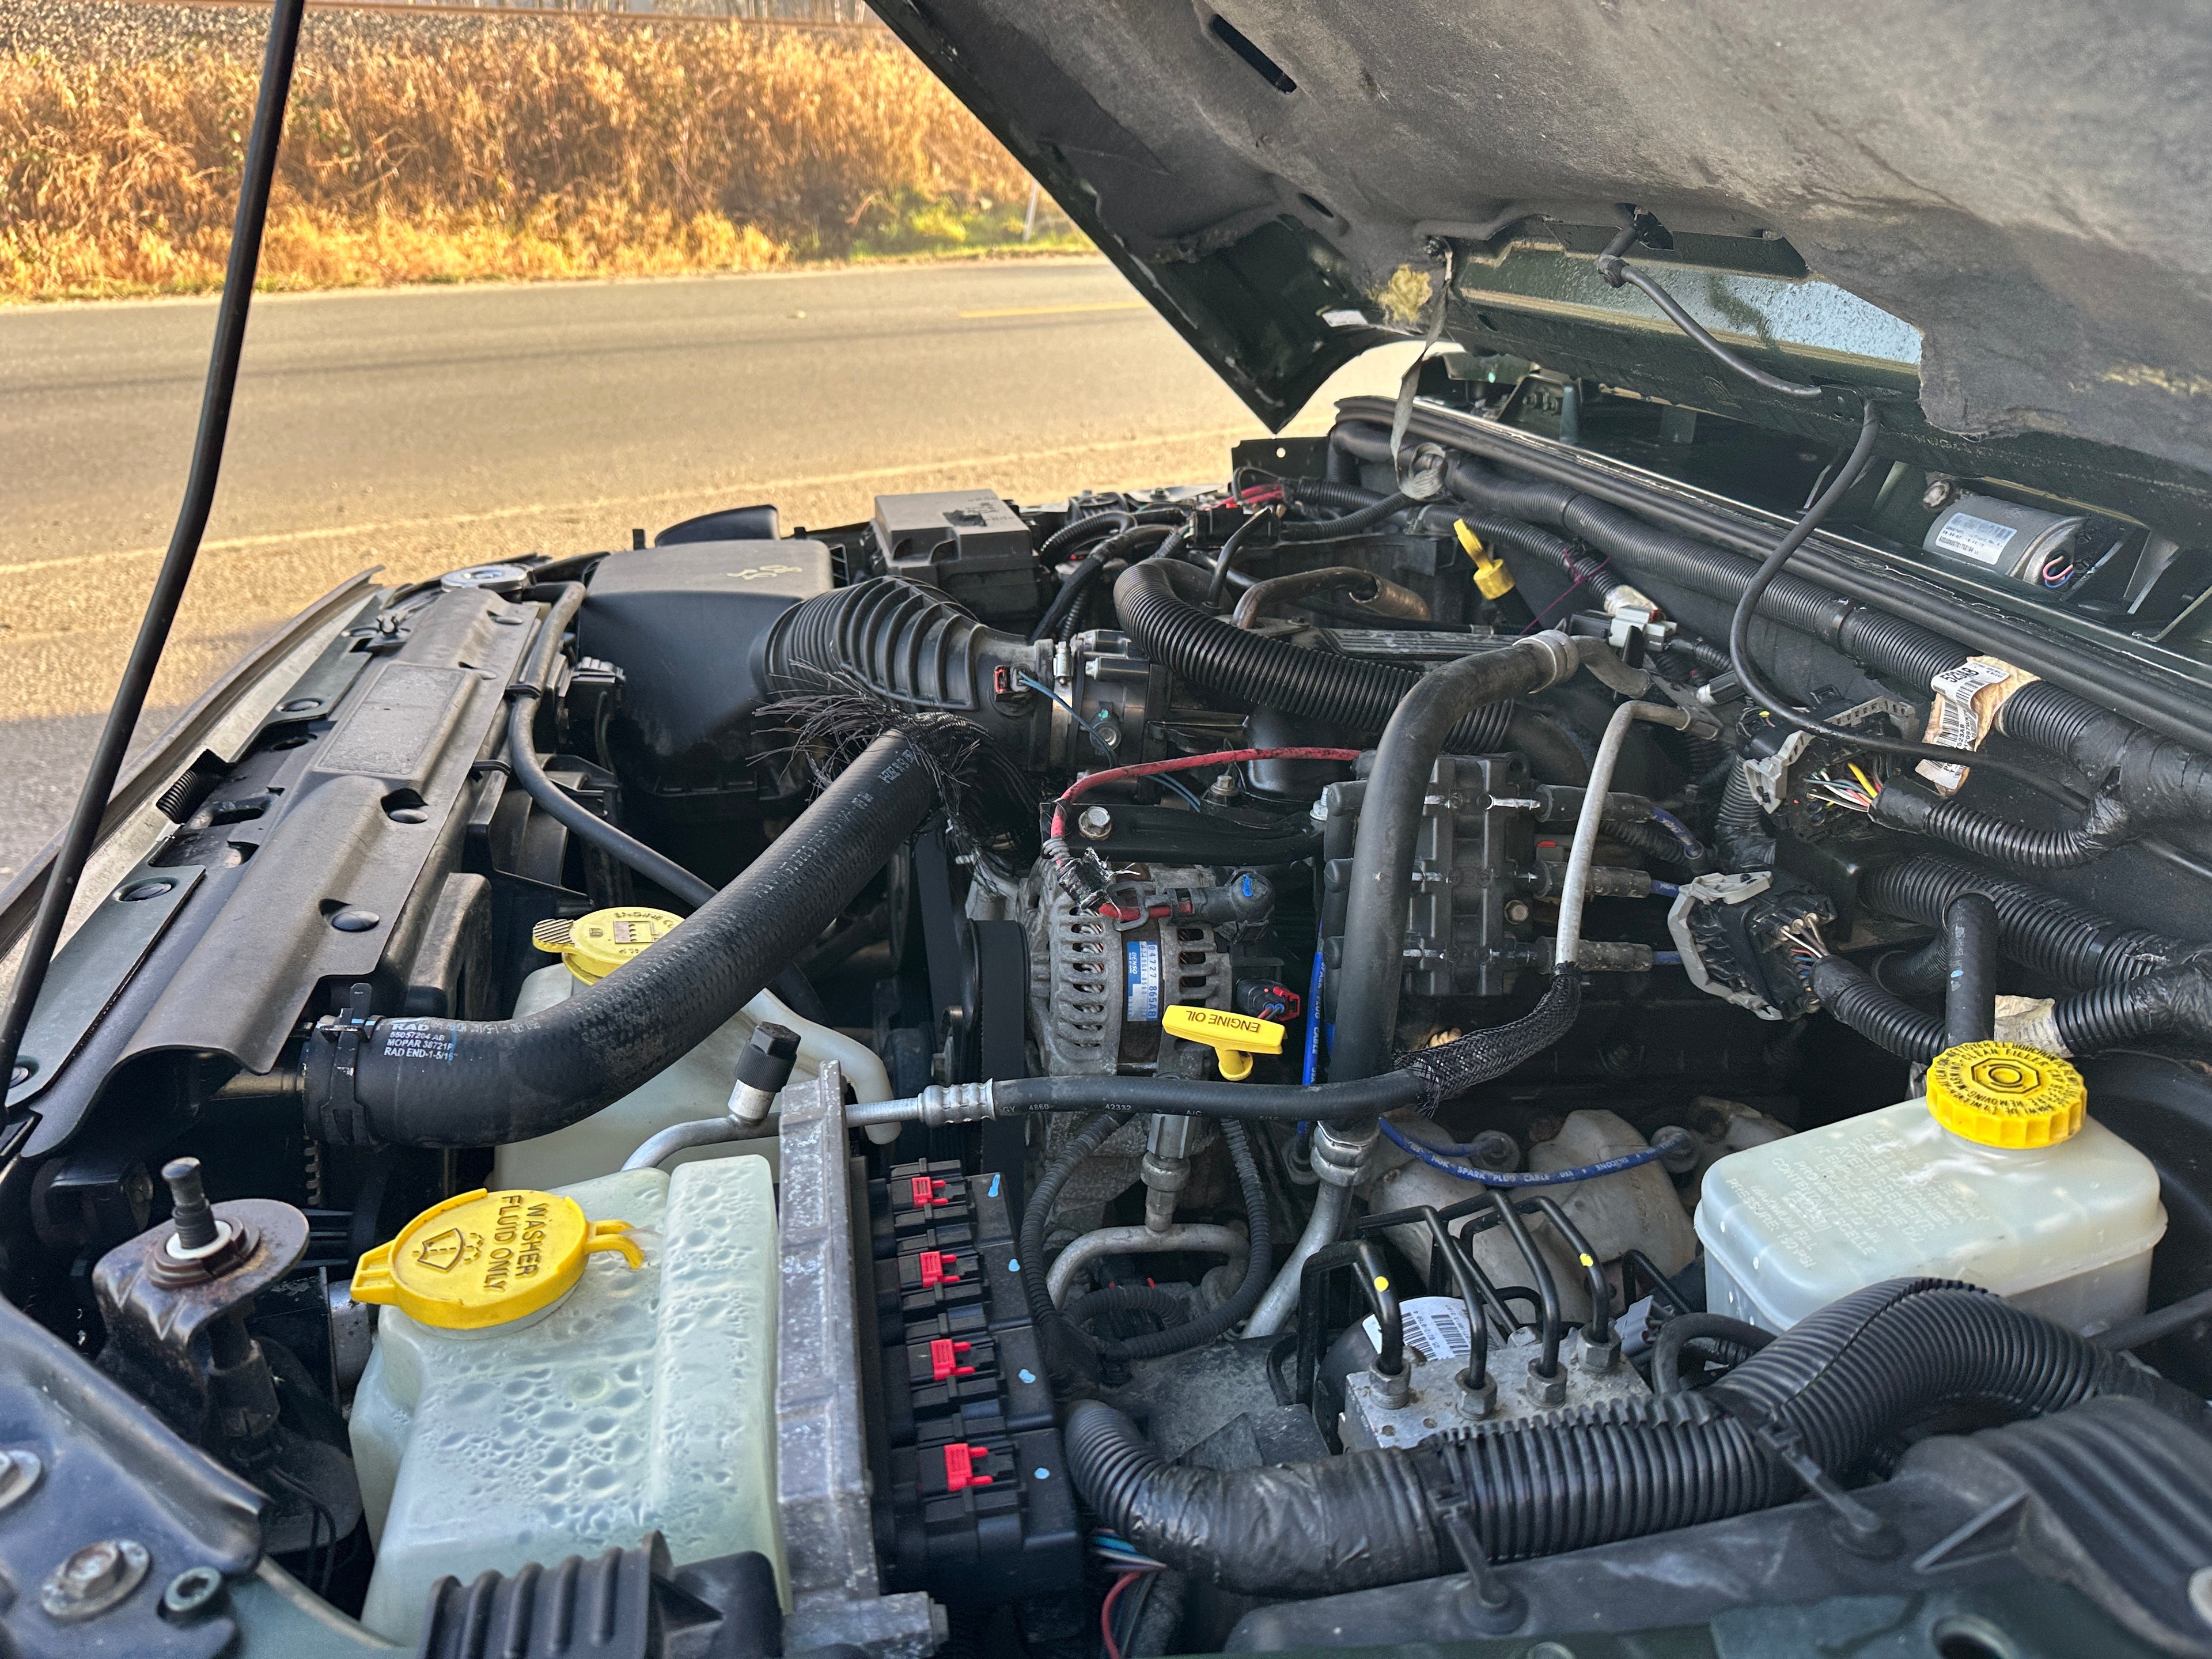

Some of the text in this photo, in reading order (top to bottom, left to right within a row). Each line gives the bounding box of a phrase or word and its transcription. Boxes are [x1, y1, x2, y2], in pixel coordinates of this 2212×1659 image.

[1148, 986, 1157, 1017] 865AB
[392, 1023, 430, 1031] RAD
[1186, 1010, 1260, 1033] ENGINE OIL
[384, 1047, 405, 1056] RAD
[387, 1039, 422, 1048] MOPAR
[1457, 1165, 1485, 1180] SPARK
[1853, 1199, 1880, 1220] DOT
[1877, 1203, 1907, 1226] QUE
[1901, 1226, 1925, 1243] DU
[483, 1194, 523, 1292] FLUID ONLY
[514, 1202, 549, 1278] WASHER
[1793, 1229, 1820, 1250] FILL
